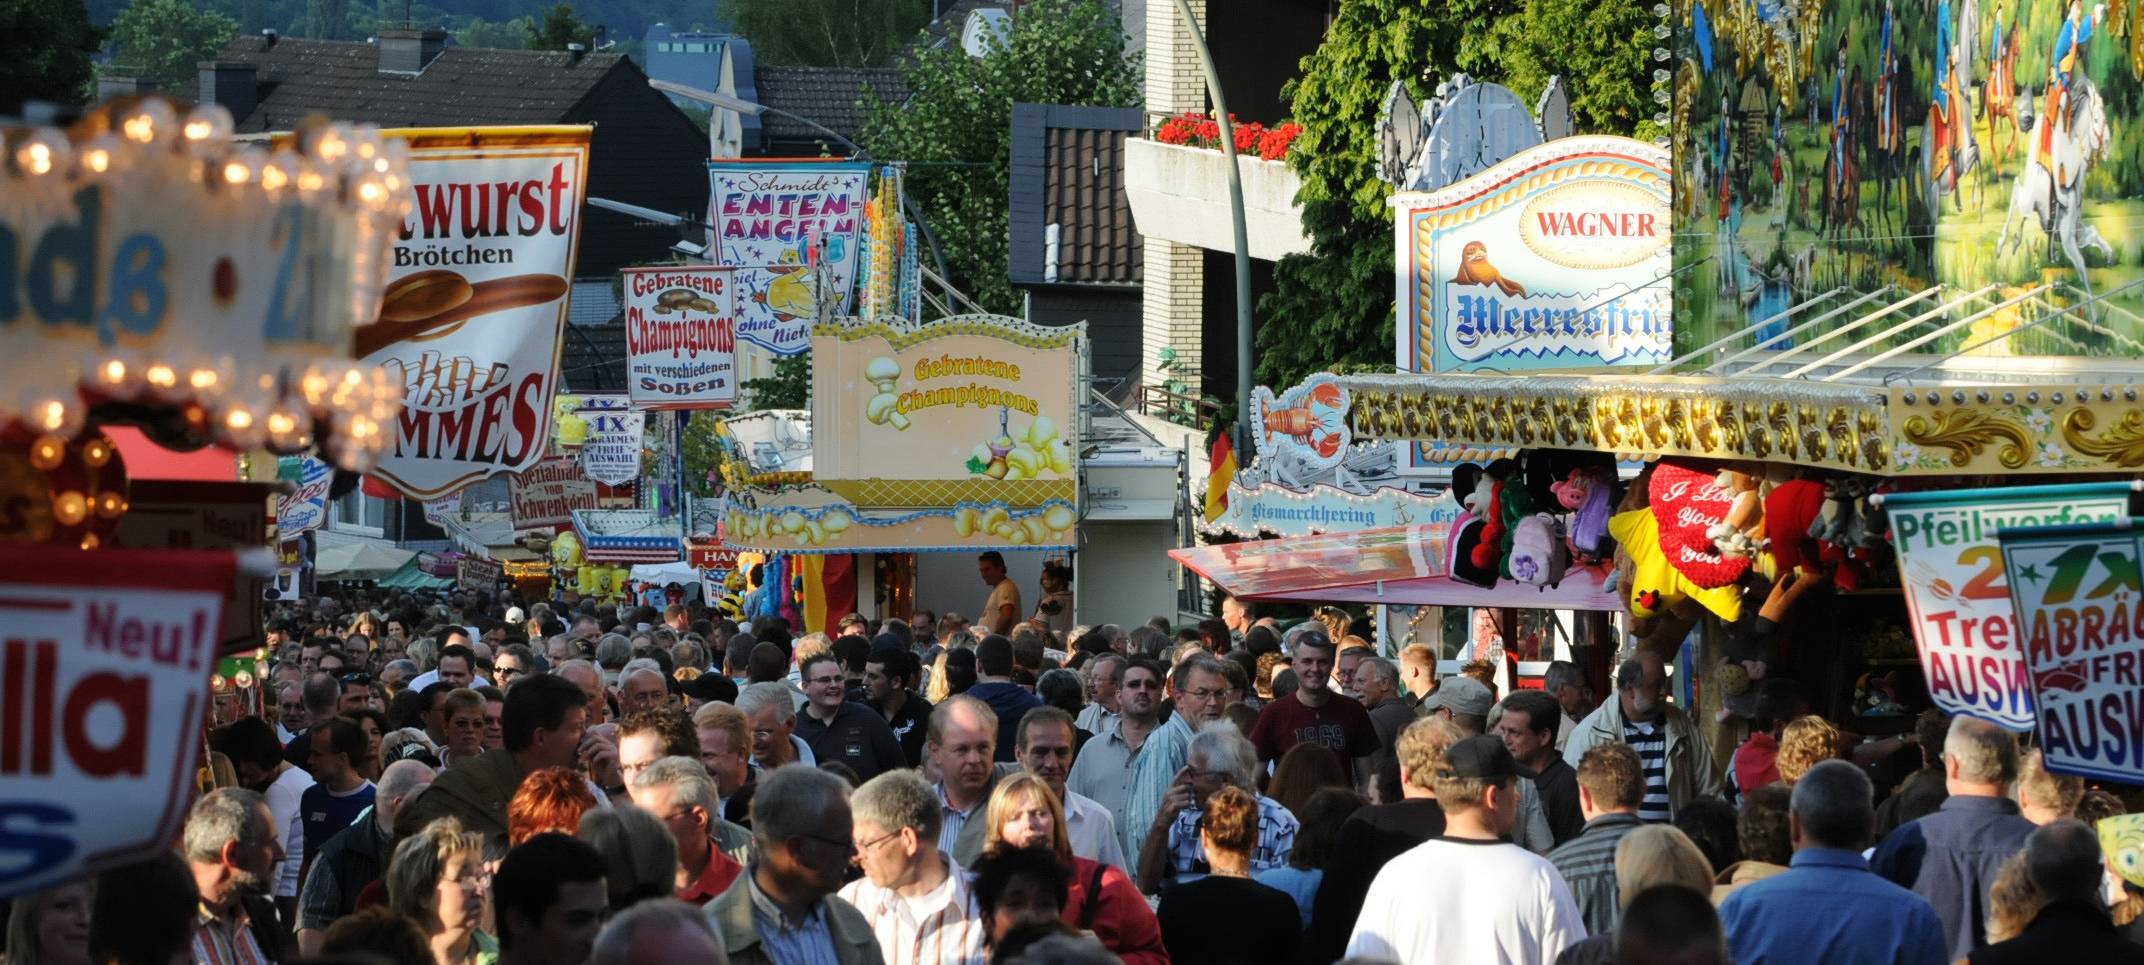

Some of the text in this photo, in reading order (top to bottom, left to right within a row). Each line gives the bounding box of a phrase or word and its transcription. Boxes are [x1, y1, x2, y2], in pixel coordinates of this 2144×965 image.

[722, 193, 863, 217] ENTEN-
[1537, 211, 1656, 237] WAGNER
[394, 244, 514, 267] Brötchen
[633, 272, 723, 298] Gebratene
[629, 306, 734, 359] Champignons
[738, 317, 777, 332] ohne
[1456, 294, 1673, 346] Meeresfrü
[634, 361, 731, 378] mit verschiedenen
[914, 353, 1021, 381] Gebratene
[896, 382, 1039, 416] Champignons
[544, 485, 564, 495] vom
[1691, 483, 1735, 505] Lov
[84, 601, 208, 671] Neu!
[2092, 650, 2144, 688] FR
